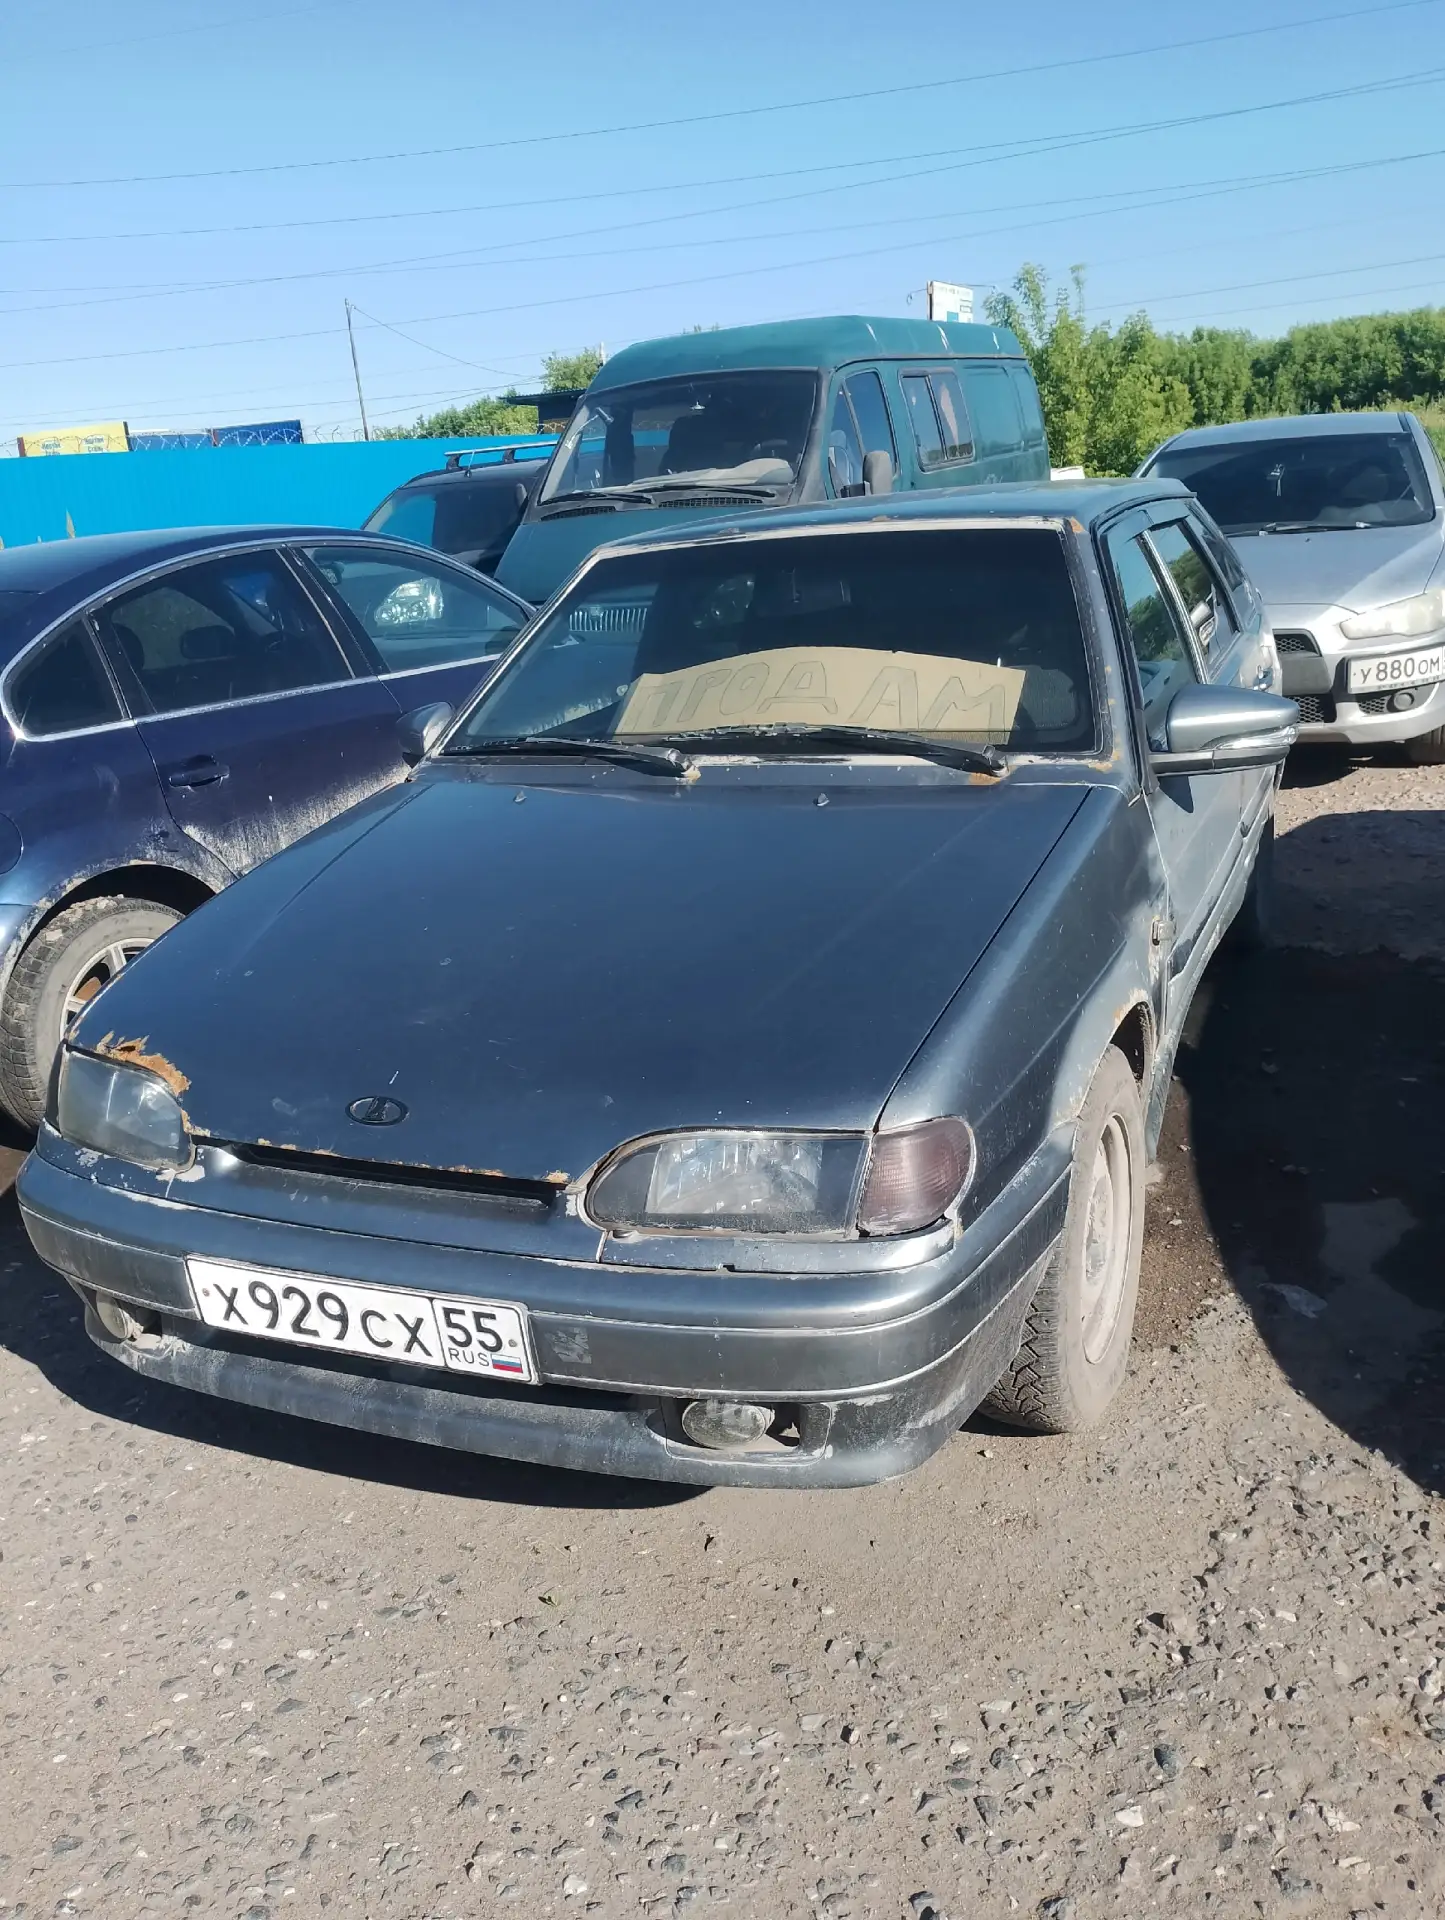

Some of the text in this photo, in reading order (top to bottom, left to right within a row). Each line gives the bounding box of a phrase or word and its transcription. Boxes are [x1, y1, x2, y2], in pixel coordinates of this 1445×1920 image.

[1360, 656, 1440, 684] У880ОМ
[621, 661, 1006, 743] ПРОДАМ
[442, 1307, 503, 1352] 55
[448, 1347, 490, 1367] RUS
